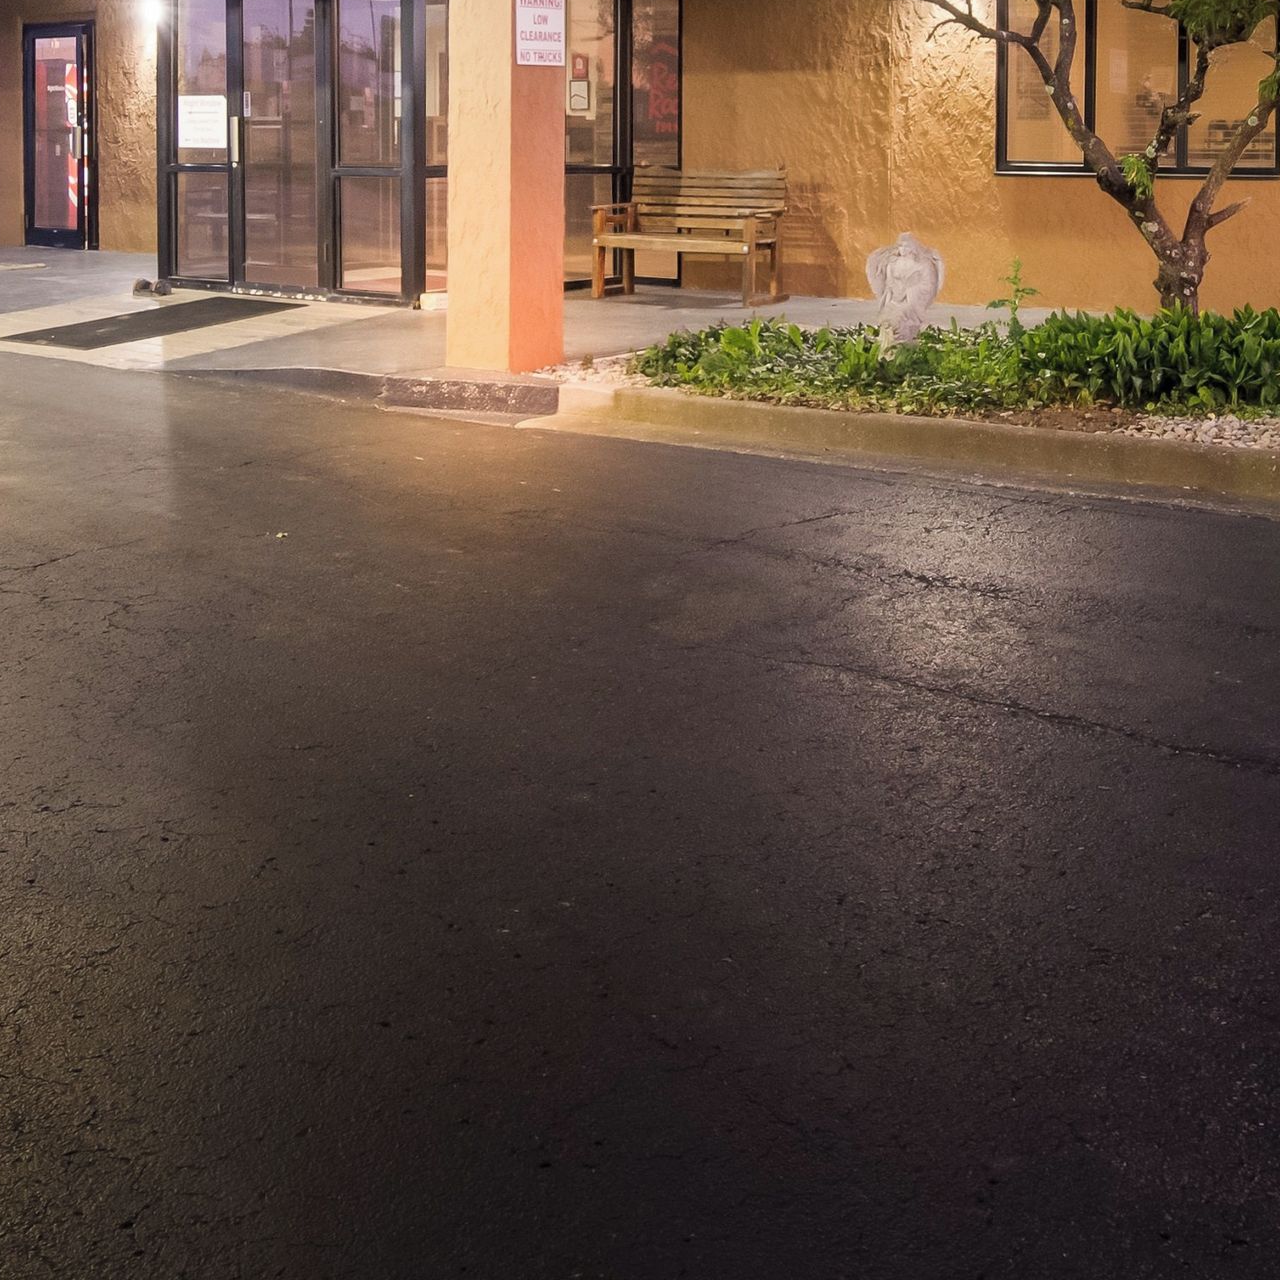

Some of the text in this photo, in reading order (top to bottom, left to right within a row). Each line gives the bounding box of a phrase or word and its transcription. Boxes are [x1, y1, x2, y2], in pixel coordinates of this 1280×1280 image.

[533, 14, 549, 25] LOW
[519, 30, 562, 42] CLEARANCE
[520, 51, 562, 63] NO TRUCKS
